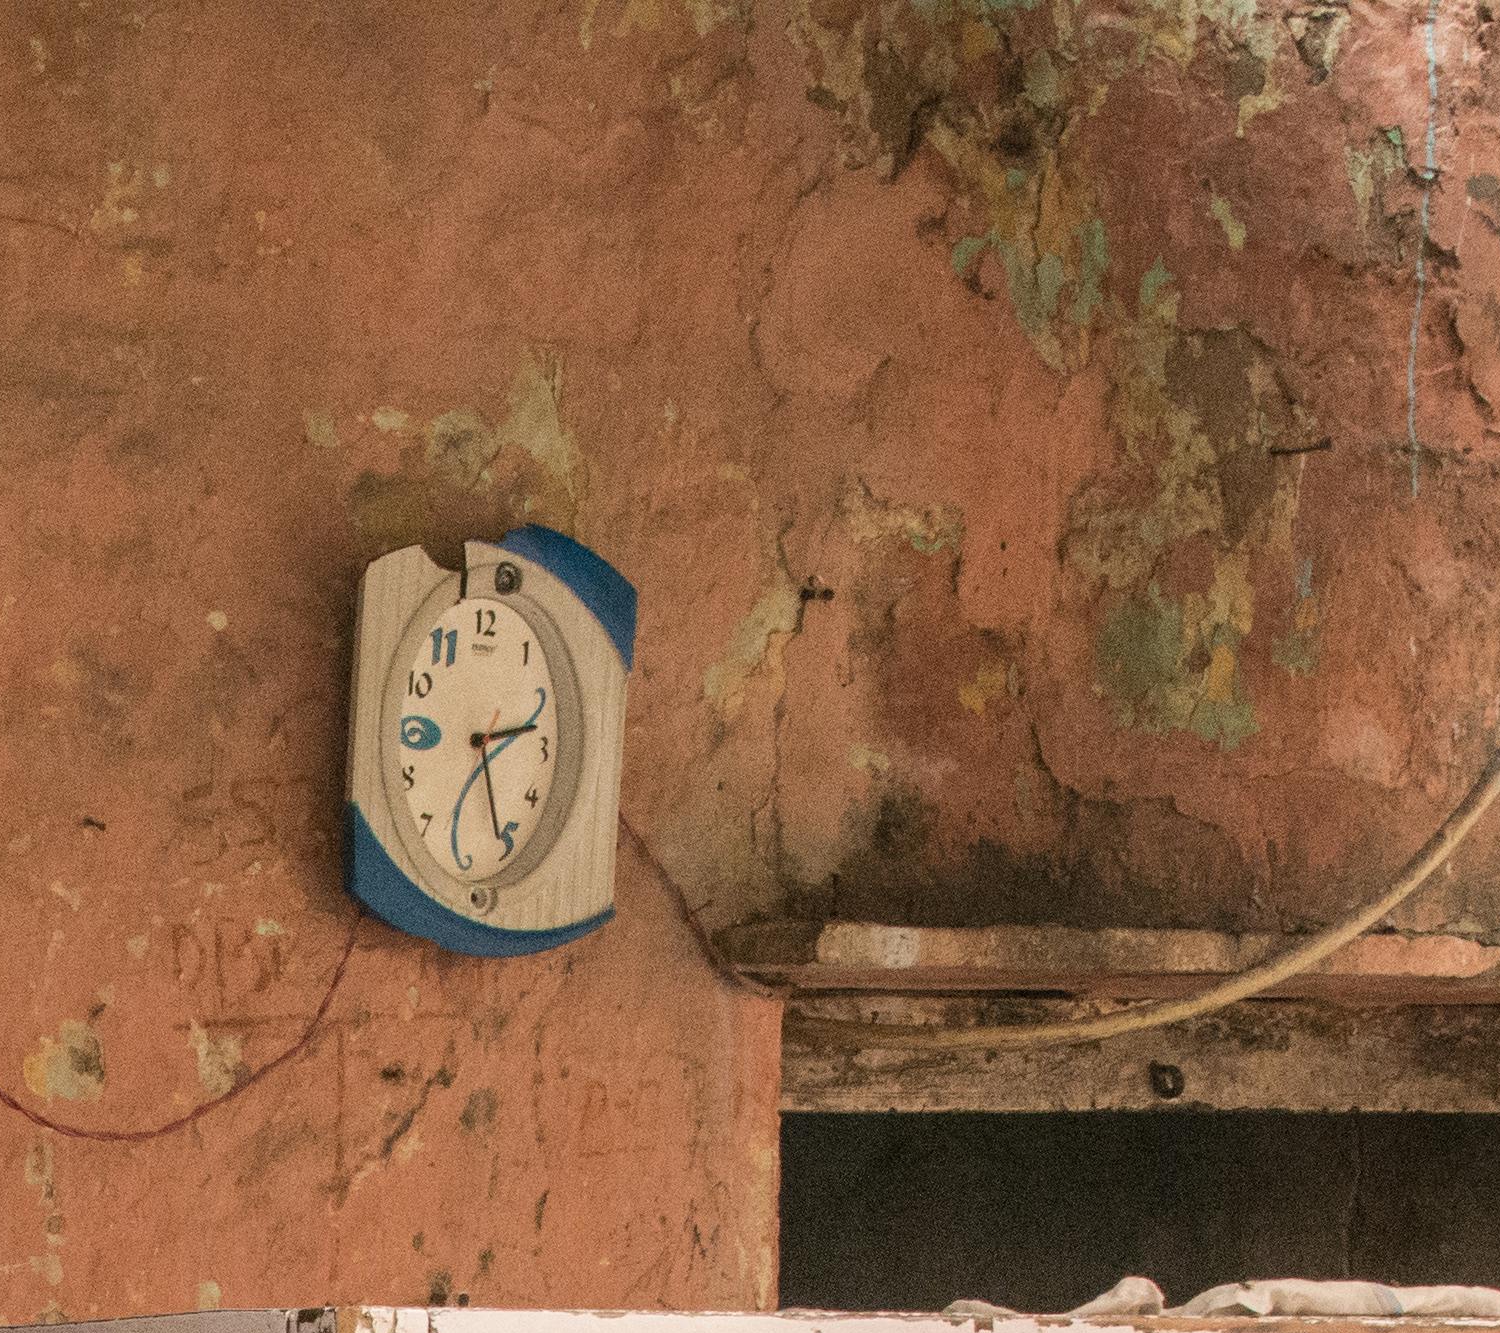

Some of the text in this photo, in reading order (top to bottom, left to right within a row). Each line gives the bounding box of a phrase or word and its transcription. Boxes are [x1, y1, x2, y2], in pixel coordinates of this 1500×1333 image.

[475, 609, 496, 637] 12
[429, 626, 458, 668] 11
[521, 641, 530, 666] 1
[408, 671, 433, 698] 10
[540, 737, 549, 764] 3
[402, 765, 414, 791] 8
[524, 787, 539, 808] 4
[420, 812, 433, 837] 7
